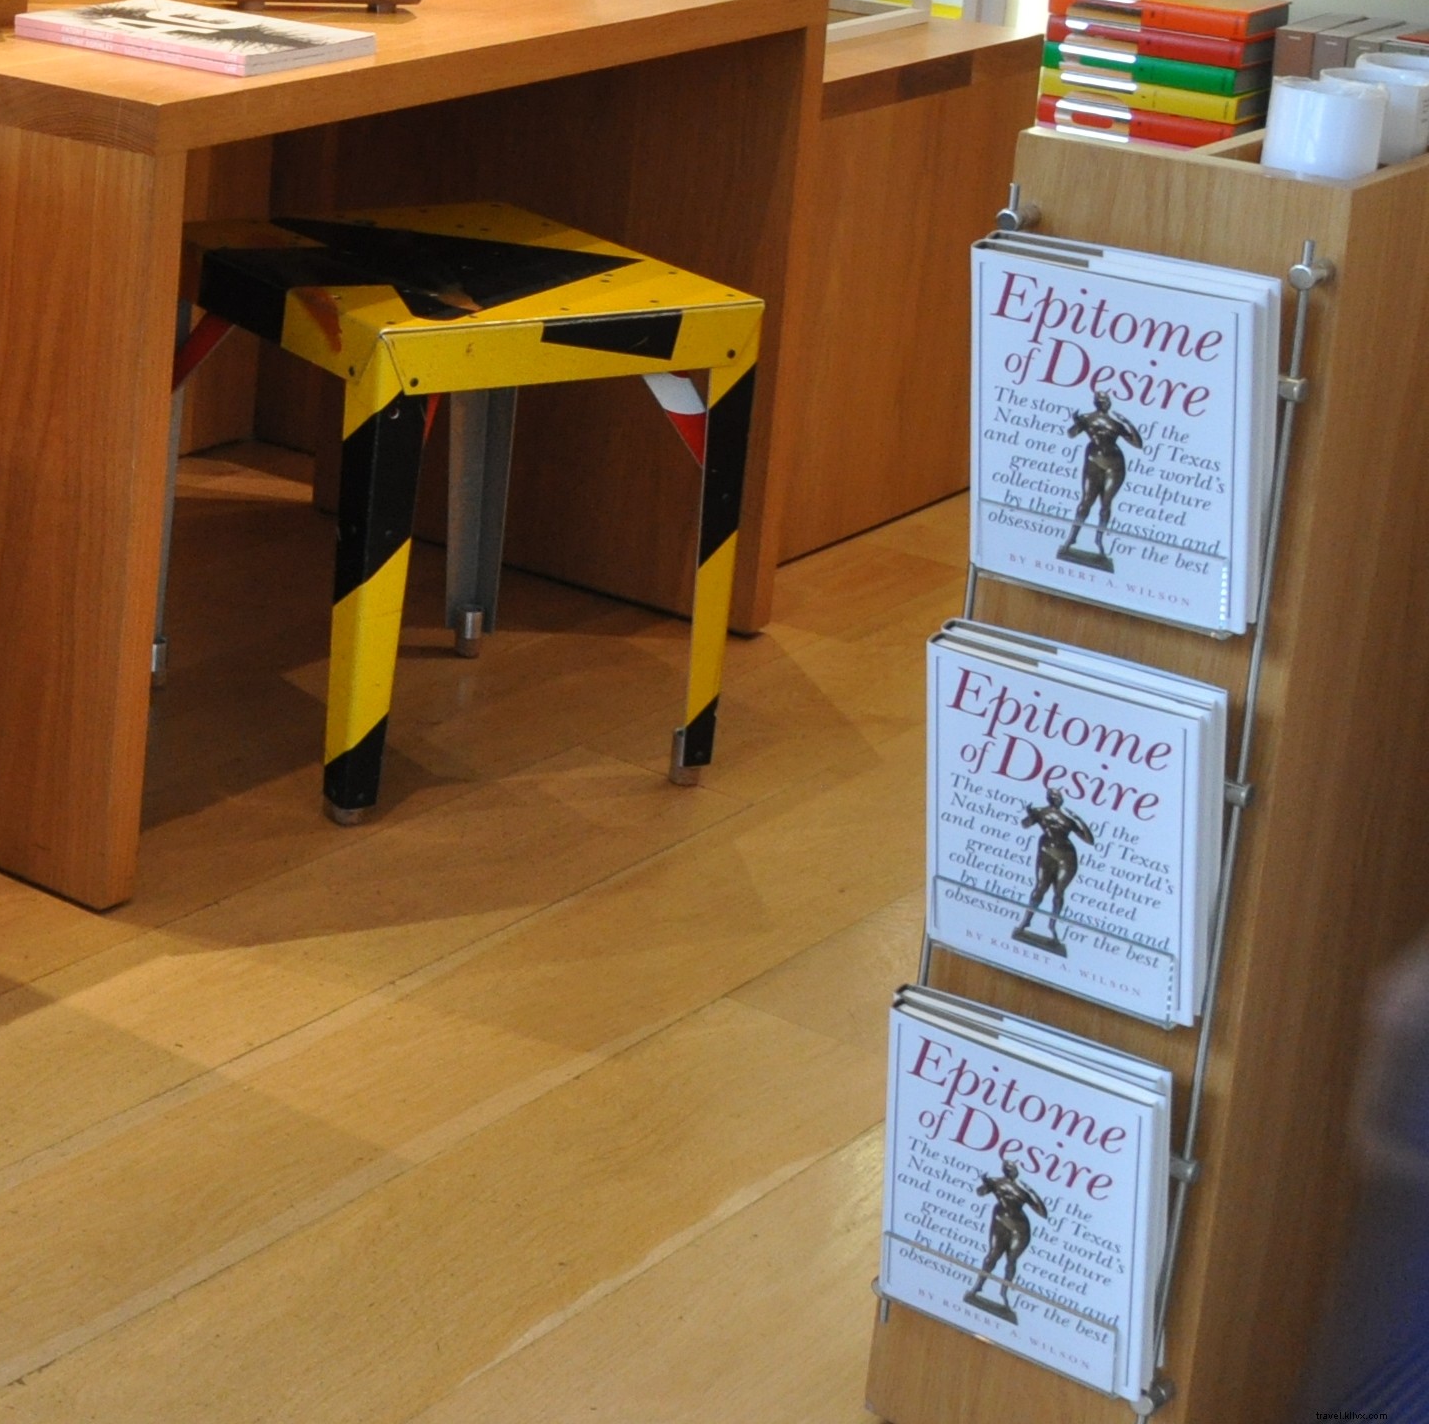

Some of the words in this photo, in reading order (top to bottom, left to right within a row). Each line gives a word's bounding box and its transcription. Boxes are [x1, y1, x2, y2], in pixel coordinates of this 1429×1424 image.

[990, 271, 1223, 362] Epitome
[994, 386, 1028, 408] The
[1032, 397, 1075, 422] story
[1138, 421, 1158, 442] of
[1161, 425, 1189, 444] the
[1004, 347, 1041, 385] of
[1036, 337, 1210, 417] Desire
[984, 430, 1020, 447] and
[1025, 437, 1056, 455] one
[1061, 444, 1082, 463] of
[1127, 458, 1155, 477] the
[1159, 468, 1225, 494] world's
[993, 407, 1065, 437] Nashers
[1143, 442, 1163, 462] of
[1168, 447, 1221, 473] Texas
[992, 469, 1081, 502] collections
[1117, 500, 1187, 527] created
[1004, 490, 1022, 511] by
[1028, 497, 1072, 519] their
[1106, 517, 1178, 545] passion
[1182, 537, 1221, 556] and
[1009, 455, 1079, 480] greatest
[1123, 479, 1212, 512] sculpture
[988, 509, 1066, 540] obsession
[1106, 537, 1136, 556] for
[1141, 544, 1169, 564] the
[1174, 552, 1210, 575] best
[1009, 553, 1027, 565] BY
[1035, 559, 1096, 582] ROBERT
[1106, 579, 1118, 589] A.
[1126, 584, 1191, 607] WILSON
[946, 666, 1172, 771] Epitome
[950, 772, 983, 795] The
[985, 786, 1028, 812] story
[1090, 820, 1109, 840] of
[1112, 825, 1140, 845] the
[959, 740, 996, 774] of
[992, 732, 1160, 821] Desire
[941, 811, 974, 830] and
[980, 822, 1011, 841] one
[1016, 833, 1036, 852] of
[1079, 853, 1106, 872] the
[1110, 865, 1175, 896] world's
[950, 792, 1020, 826] Nashers
[1093, 840, 1113, 860] of
[1118, 845, 1170, 874] Texas
[949, 850, 1035, 887] collections
[1070, 892, 1137, 922] created
[960, 870, 978, 888] by
[984, 878, 1026, 902] their
[1060, 904, 1129, 937] passion
[1132, 931, 1170, 951] and
[965, 838, 1032, 867] greatest
[1076, 874, 1162, 910] sculpture
[944, 886, 1021, 922] obsession
[1061, 926, 1089, 942] for
[1093, 936, 1120, 956] the
[1125, 945, 1160, 969] best
[966, 929, 983, 940] BY
[991, 939, 1051, 964] ROBERT
[1059, 962, 1071, 972] A.
[1079, 969, 1141, 997] WILSON
[906, 1036, 1126, 1154] Epitome
[909, 1136, 940, 1161] The
[942, 1153, 983, 1181] story
[1043, 1194, 1063, 1213] of
[1065, 1200, 1092, 1221] the
[918, 1109, 953, 1140] of
[948, 1103, 1113, 1201] Desire
[897, 1171, 930, 1193] and
[936, 1185, 966, 1207] one
[970, 1200, 990, 1219] of
[1032, 1225, 1058, 1245] the
[1062, 1239, 1126, 1275] world's
[907, 1155, 974, 1193] Nashers
[1047, 1214, 1067, 1233] of
[1071, 1220, 1122, 1254] Texas
[920, 1200, 986, 1233] greatest
[1029, 1245, 1112, 1288] sculpture
[904, 1210, 987, 1253] collections
[1022, 1261, 1087, 1296] created
